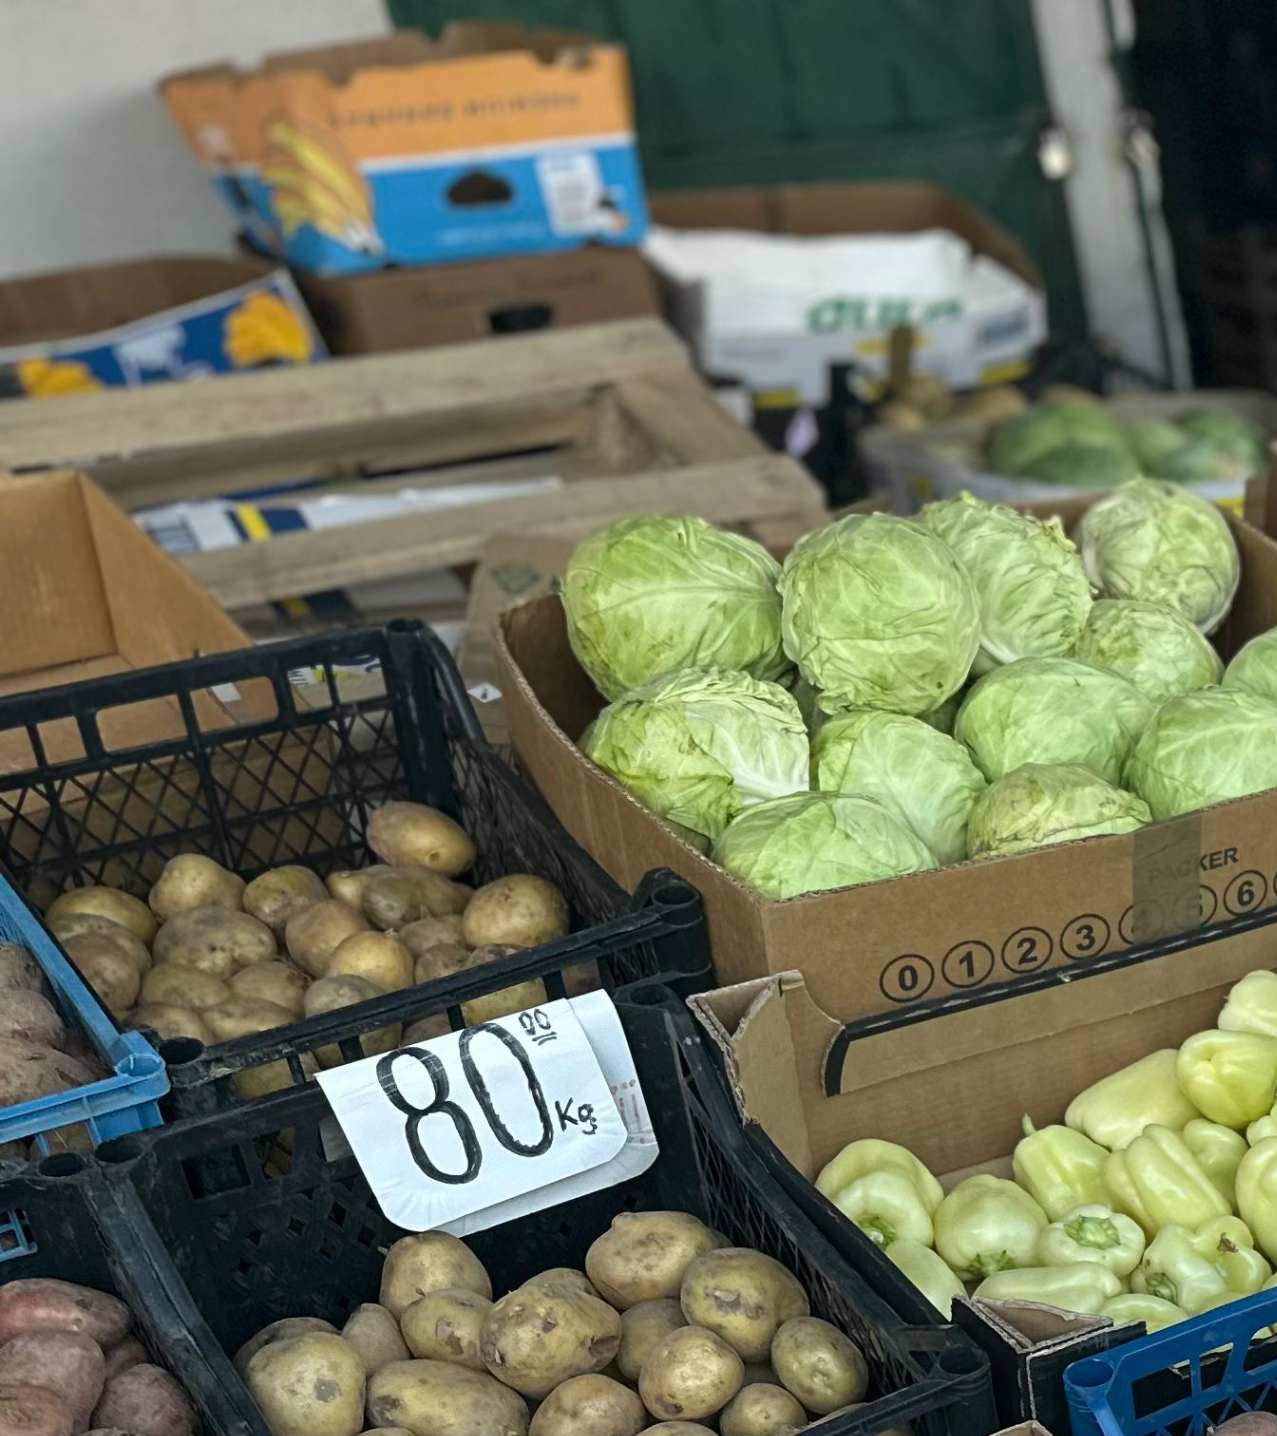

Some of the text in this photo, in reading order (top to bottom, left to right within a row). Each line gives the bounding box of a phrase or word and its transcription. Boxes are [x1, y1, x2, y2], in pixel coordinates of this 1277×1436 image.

[899, 965, 919, 992] 0
[960, 951, 976, 978] 1
[1017, 937, 1038, 963] 2
[1075, 924, 1096, 951] 3
[1237, 880, 1255, 906] 6
[376, 1008, 598, 1185] 80 00 Kg
